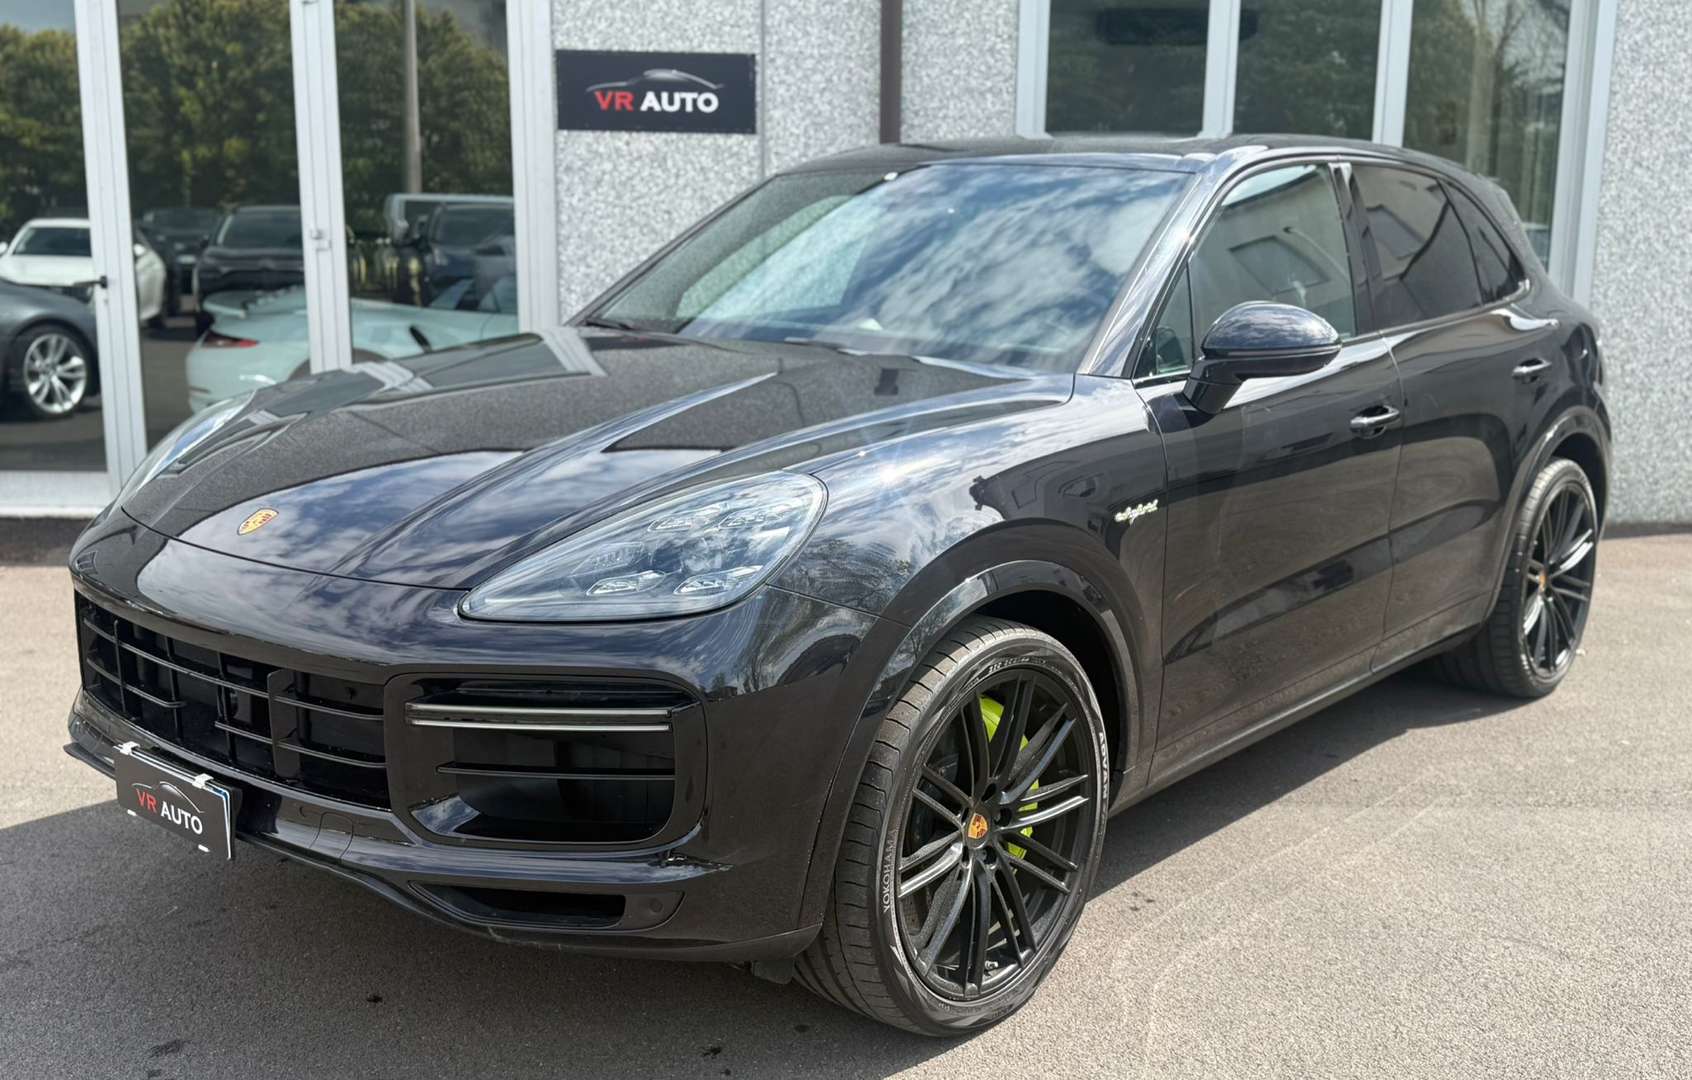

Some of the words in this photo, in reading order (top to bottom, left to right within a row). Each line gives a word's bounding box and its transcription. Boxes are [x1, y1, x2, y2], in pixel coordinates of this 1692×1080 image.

[594, 91, 634, 112] VR
[640, 91, 719, 113] AUTO
[136, 788, 157, 814] VR
[161, 801, 203, 834] AUTO
[883, 829, 898, 913] YOKOHAMA
